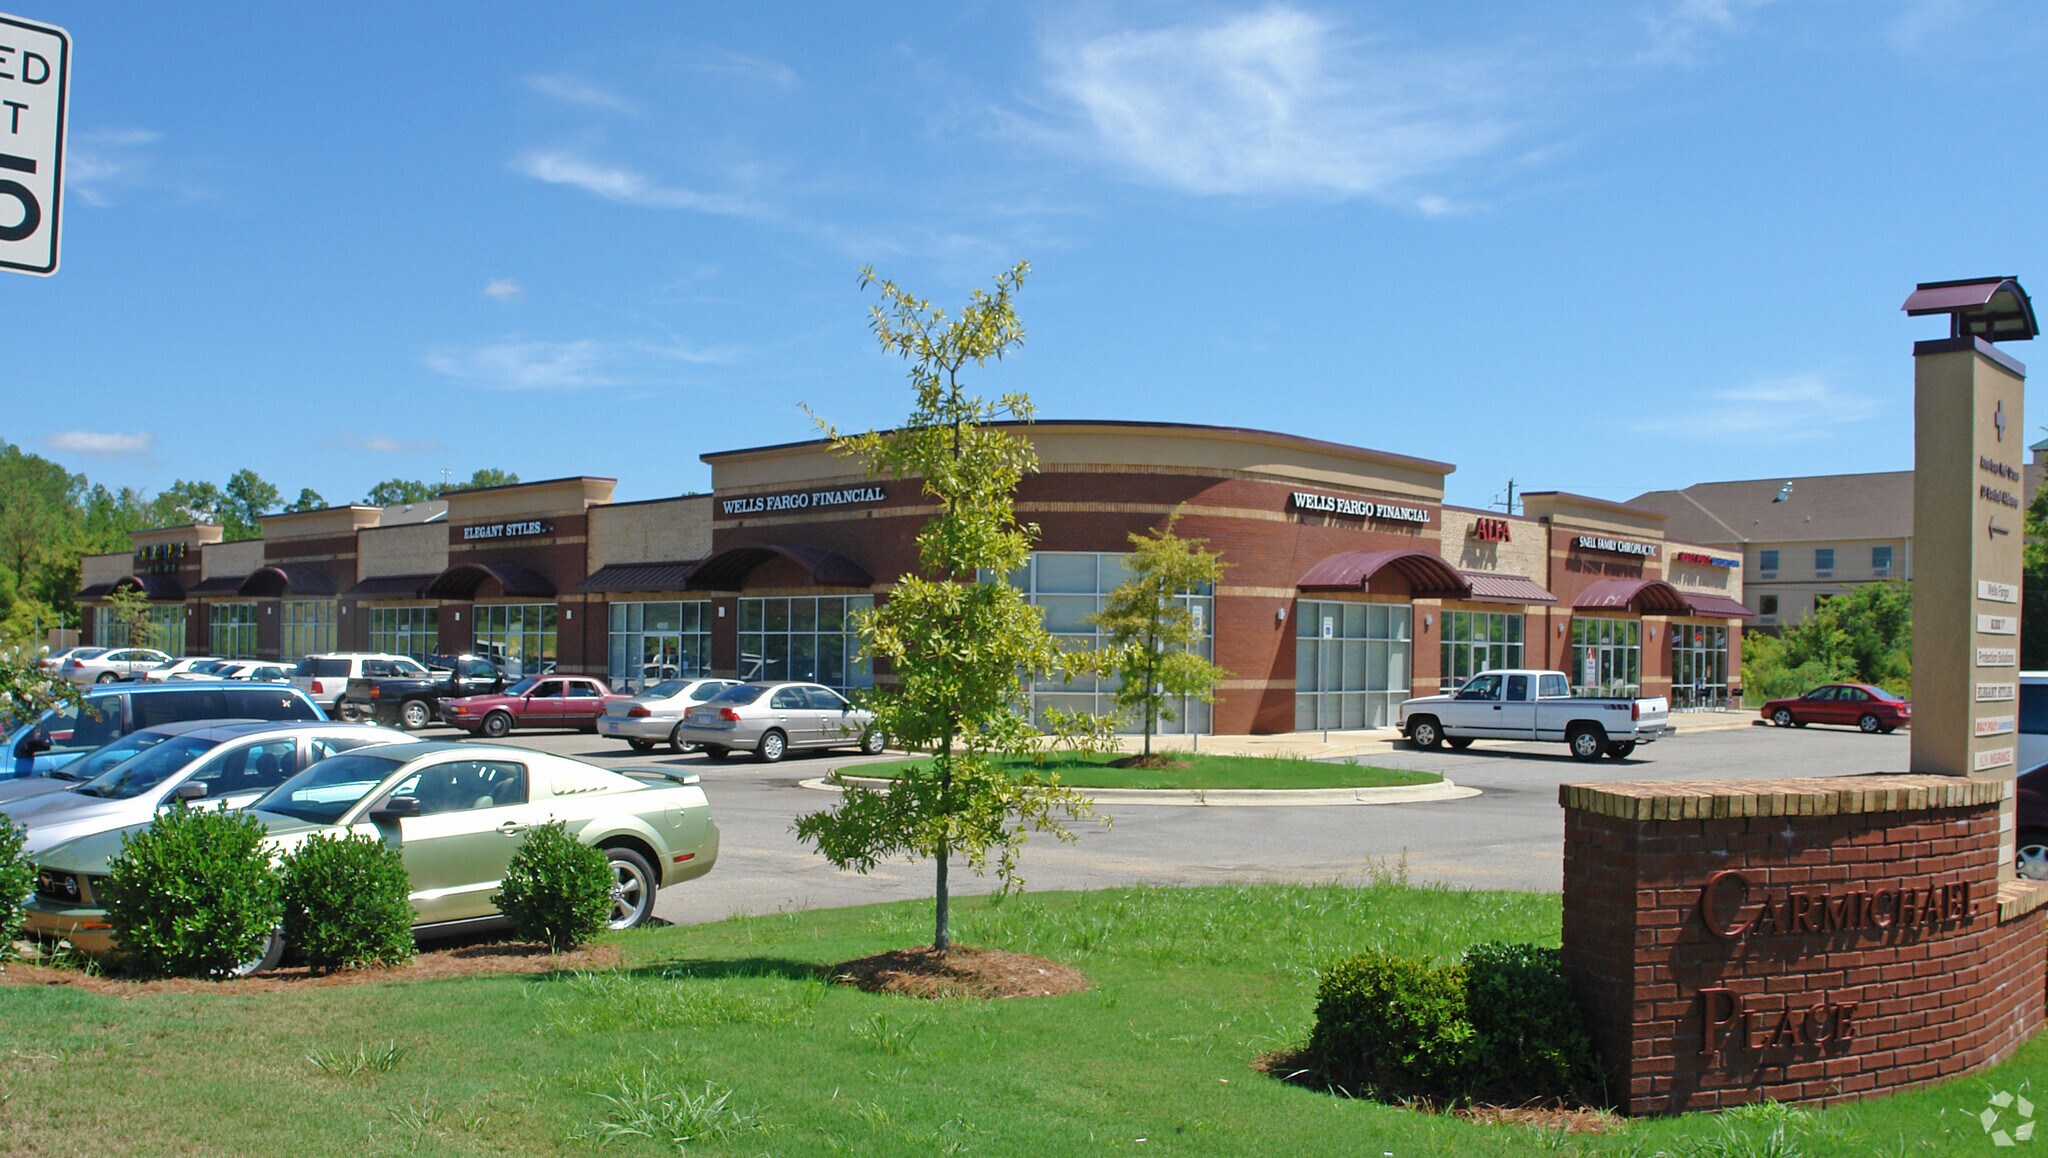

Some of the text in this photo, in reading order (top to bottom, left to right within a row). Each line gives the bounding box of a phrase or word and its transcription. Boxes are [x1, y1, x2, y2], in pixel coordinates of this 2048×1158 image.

[723, 487, 884, 514] WELLS FARGO FINANCIAL
[1293, 492, 1430, 522] WELLS FARGO FINANCIAL
[464, 524, 504, 539] ELEGANT
[506, 521, 541, 536] STYLES
[1475, 516, 1512, 544] ALFA
[1579, 536, 1656, 556] SNELL FAMILY CHIROPRACTIC
[1702, 869, 1979, 939] CARMICHAEL
[1698, 987, 1858, 1054] PLACE
